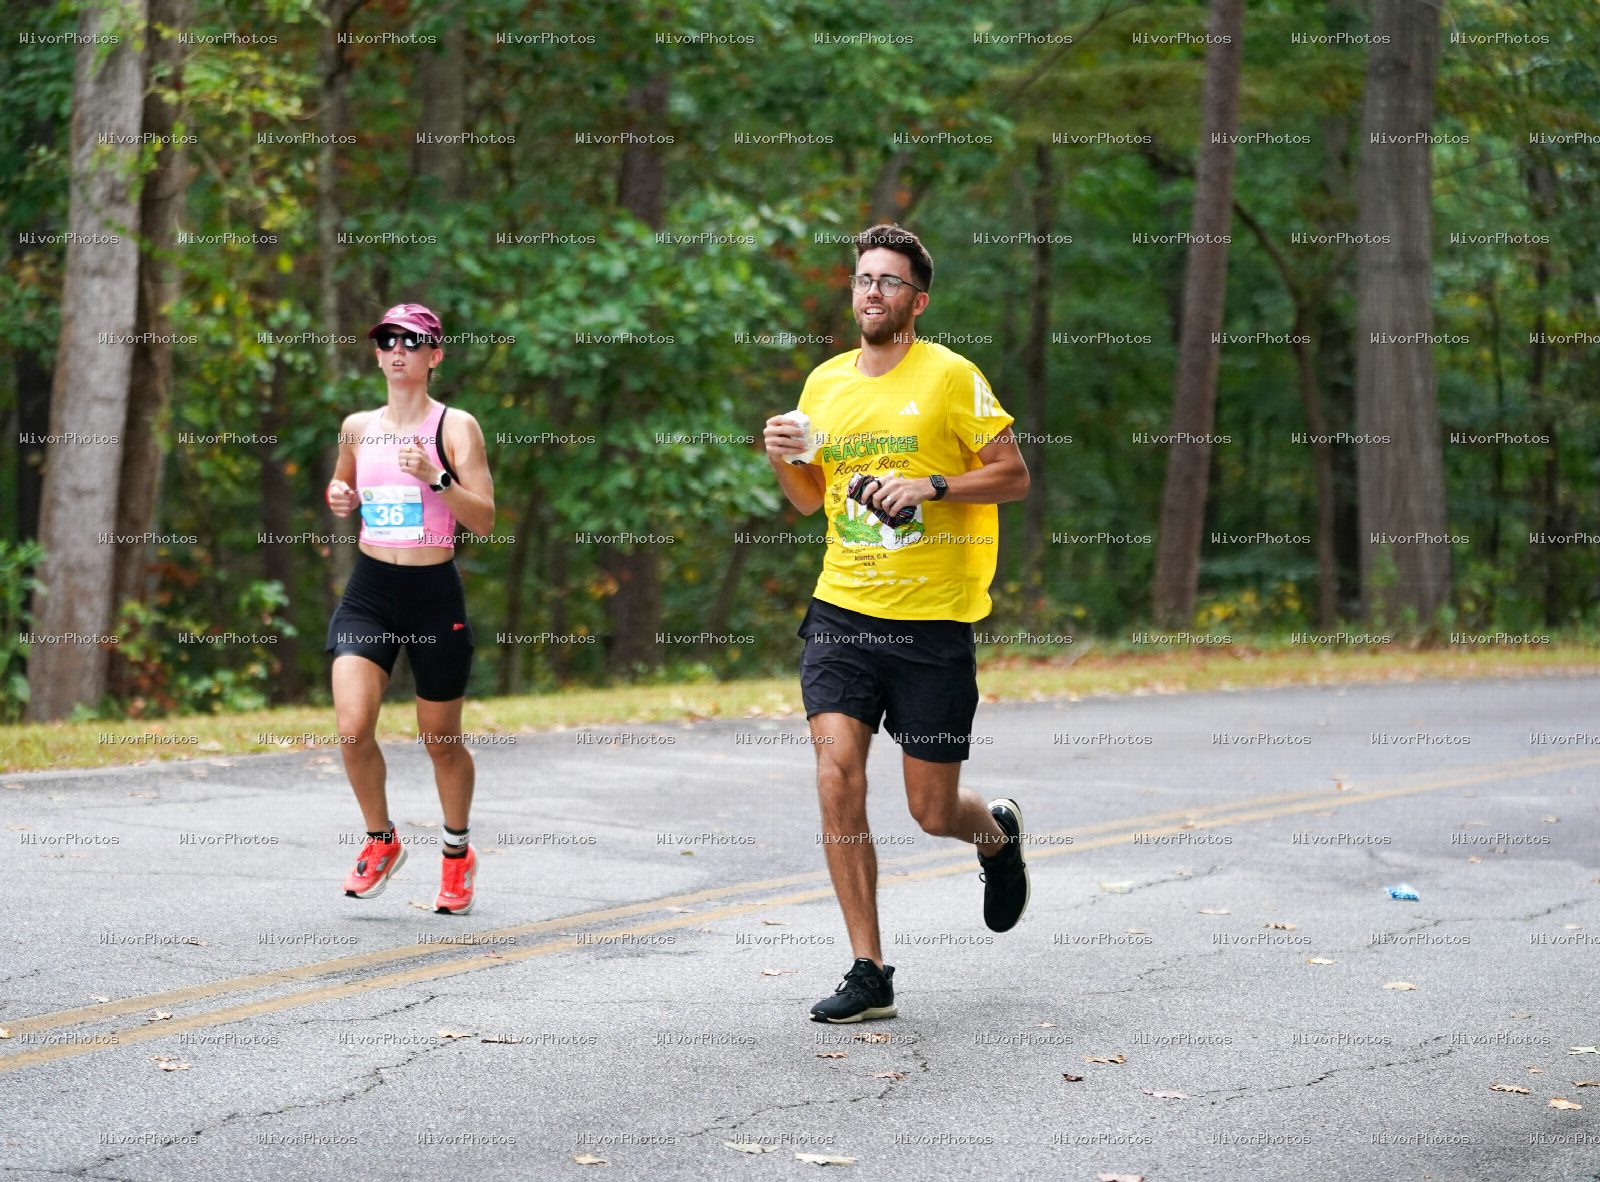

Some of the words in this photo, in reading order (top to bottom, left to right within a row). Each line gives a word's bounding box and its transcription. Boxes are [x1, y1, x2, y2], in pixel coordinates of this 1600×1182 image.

[823, 436, 918, 463] PEACHTREE
[834, 460, 874, 475] Road
[875, 456, 910, 470] Race
[375, 505, 405, 526] 36
